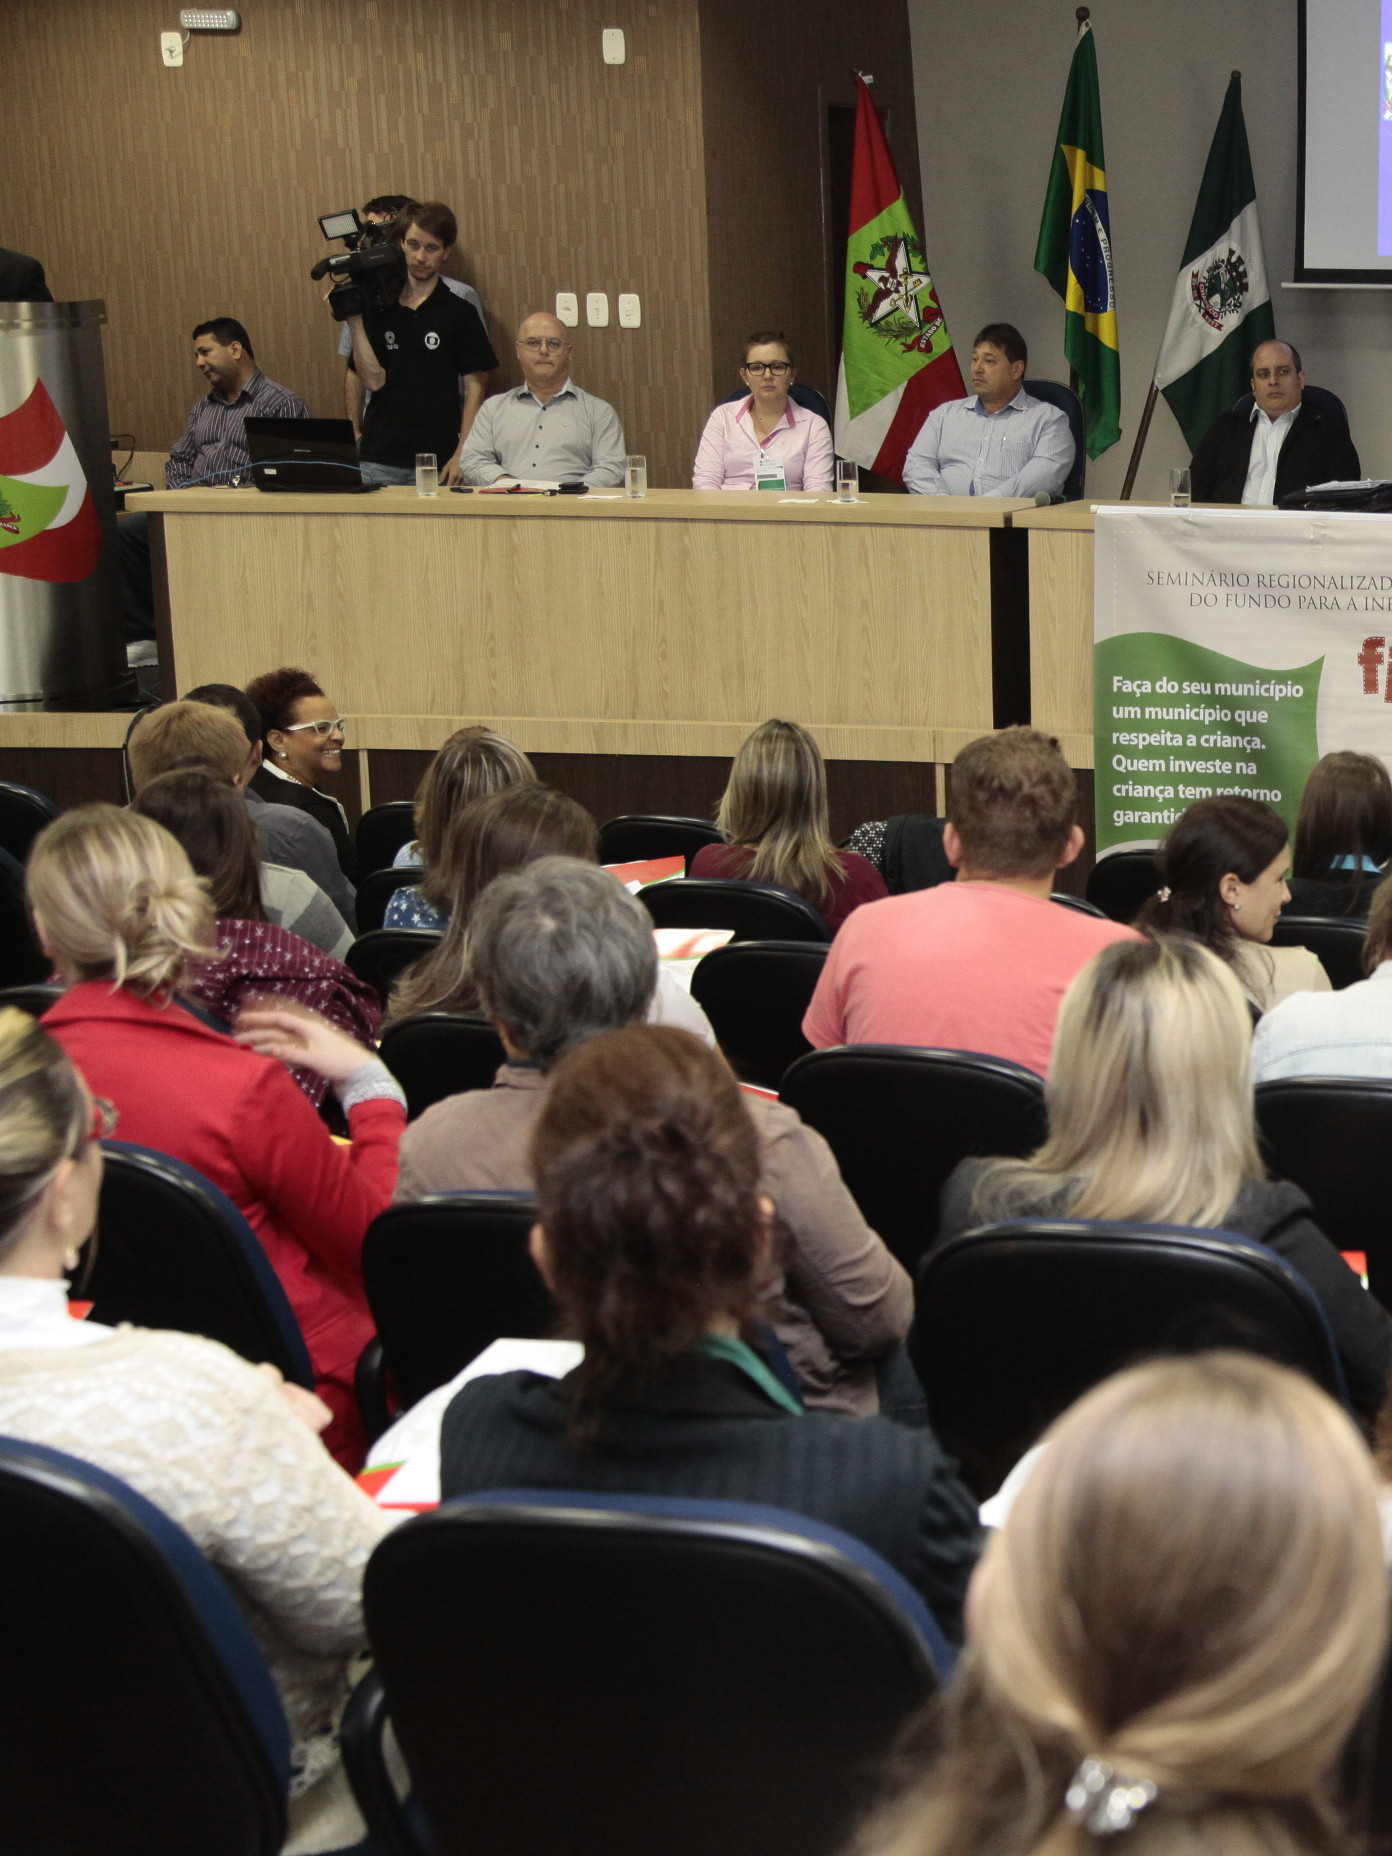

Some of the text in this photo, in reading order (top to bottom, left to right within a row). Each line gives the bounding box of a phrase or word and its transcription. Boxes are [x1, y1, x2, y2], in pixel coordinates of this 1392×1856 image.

[1147, 569, 1250, 588] SEMINÁRIO
[1189, 592, 1218, 608] DO
[1225, 593, 1291, 609] FUNDO
[1298, 595, 1341, 611] PARA
[1346, 596, 1358, 611] A
[1112, 676, 1304, 701] Faça do seu município
[1112, 704, 1268, 726] um município que
[1112, 729, 1266, 753] respeita a criança.
[1112, 754, 1257, 775] Quem investe na
[1112, 781, 1282, 802] criança tem retorno
